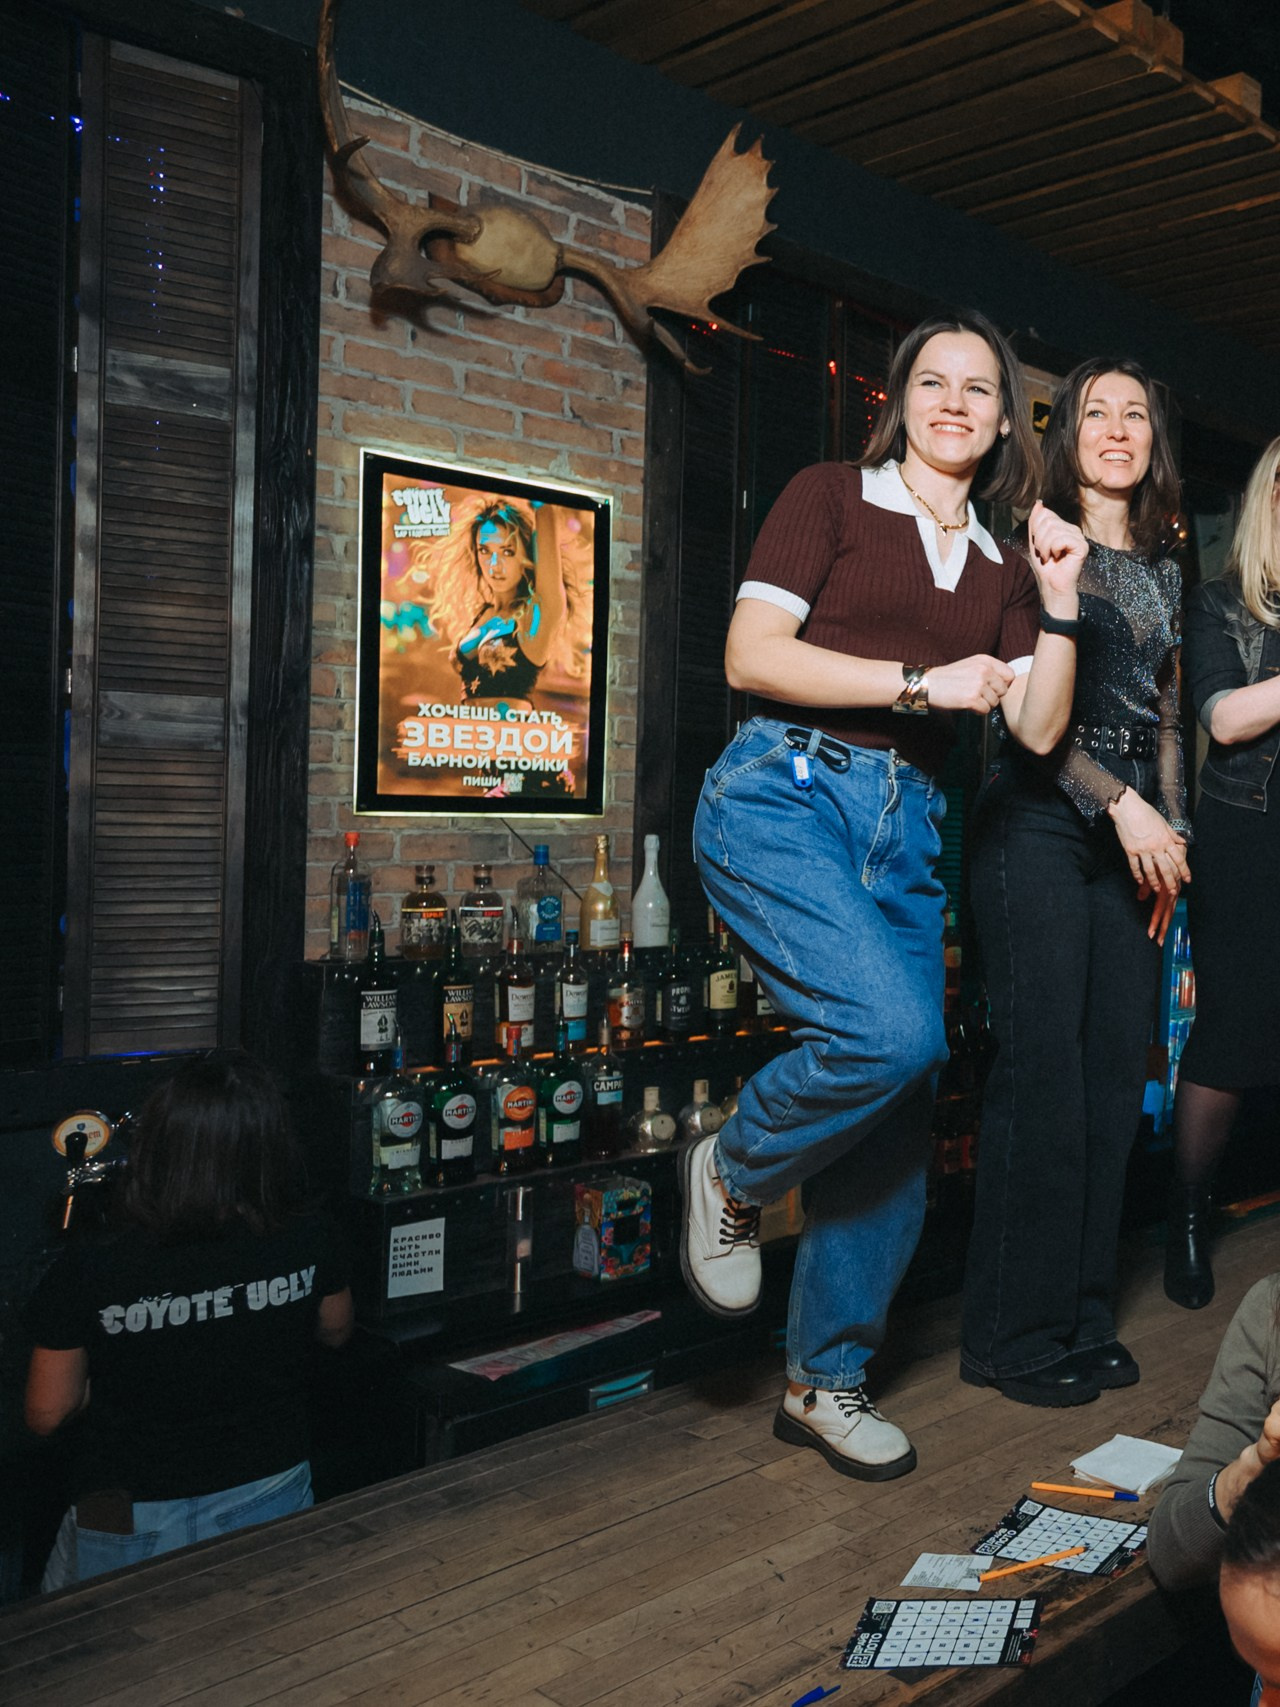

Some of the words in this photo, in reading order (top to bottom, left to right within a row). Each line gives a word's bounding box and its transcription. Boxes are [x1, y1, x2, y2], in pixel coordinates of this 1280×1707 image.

[417, 703, 500, 721] ХОЧЕШЬ
[505, 708, 562, 725] СТАТЬ
[402, 721, 573, 756] ЗВЕЗДОЙ
[407, 751, 491, 769] БАРНОЙ
[495, 754, 569, 771] СТОЙКИ
[593, 1080, 623, 1092] CAMPA
[393, 1232, 441, 1243] КРАСИВО
[392, 1249, 441, 1260] СЧАСТЛИ
[393, 1243, 420, 1252] БЫТЬ
[99, 1286, 234, 1334] COYOTE
[246, 1265, 316, 1311] UGLY
